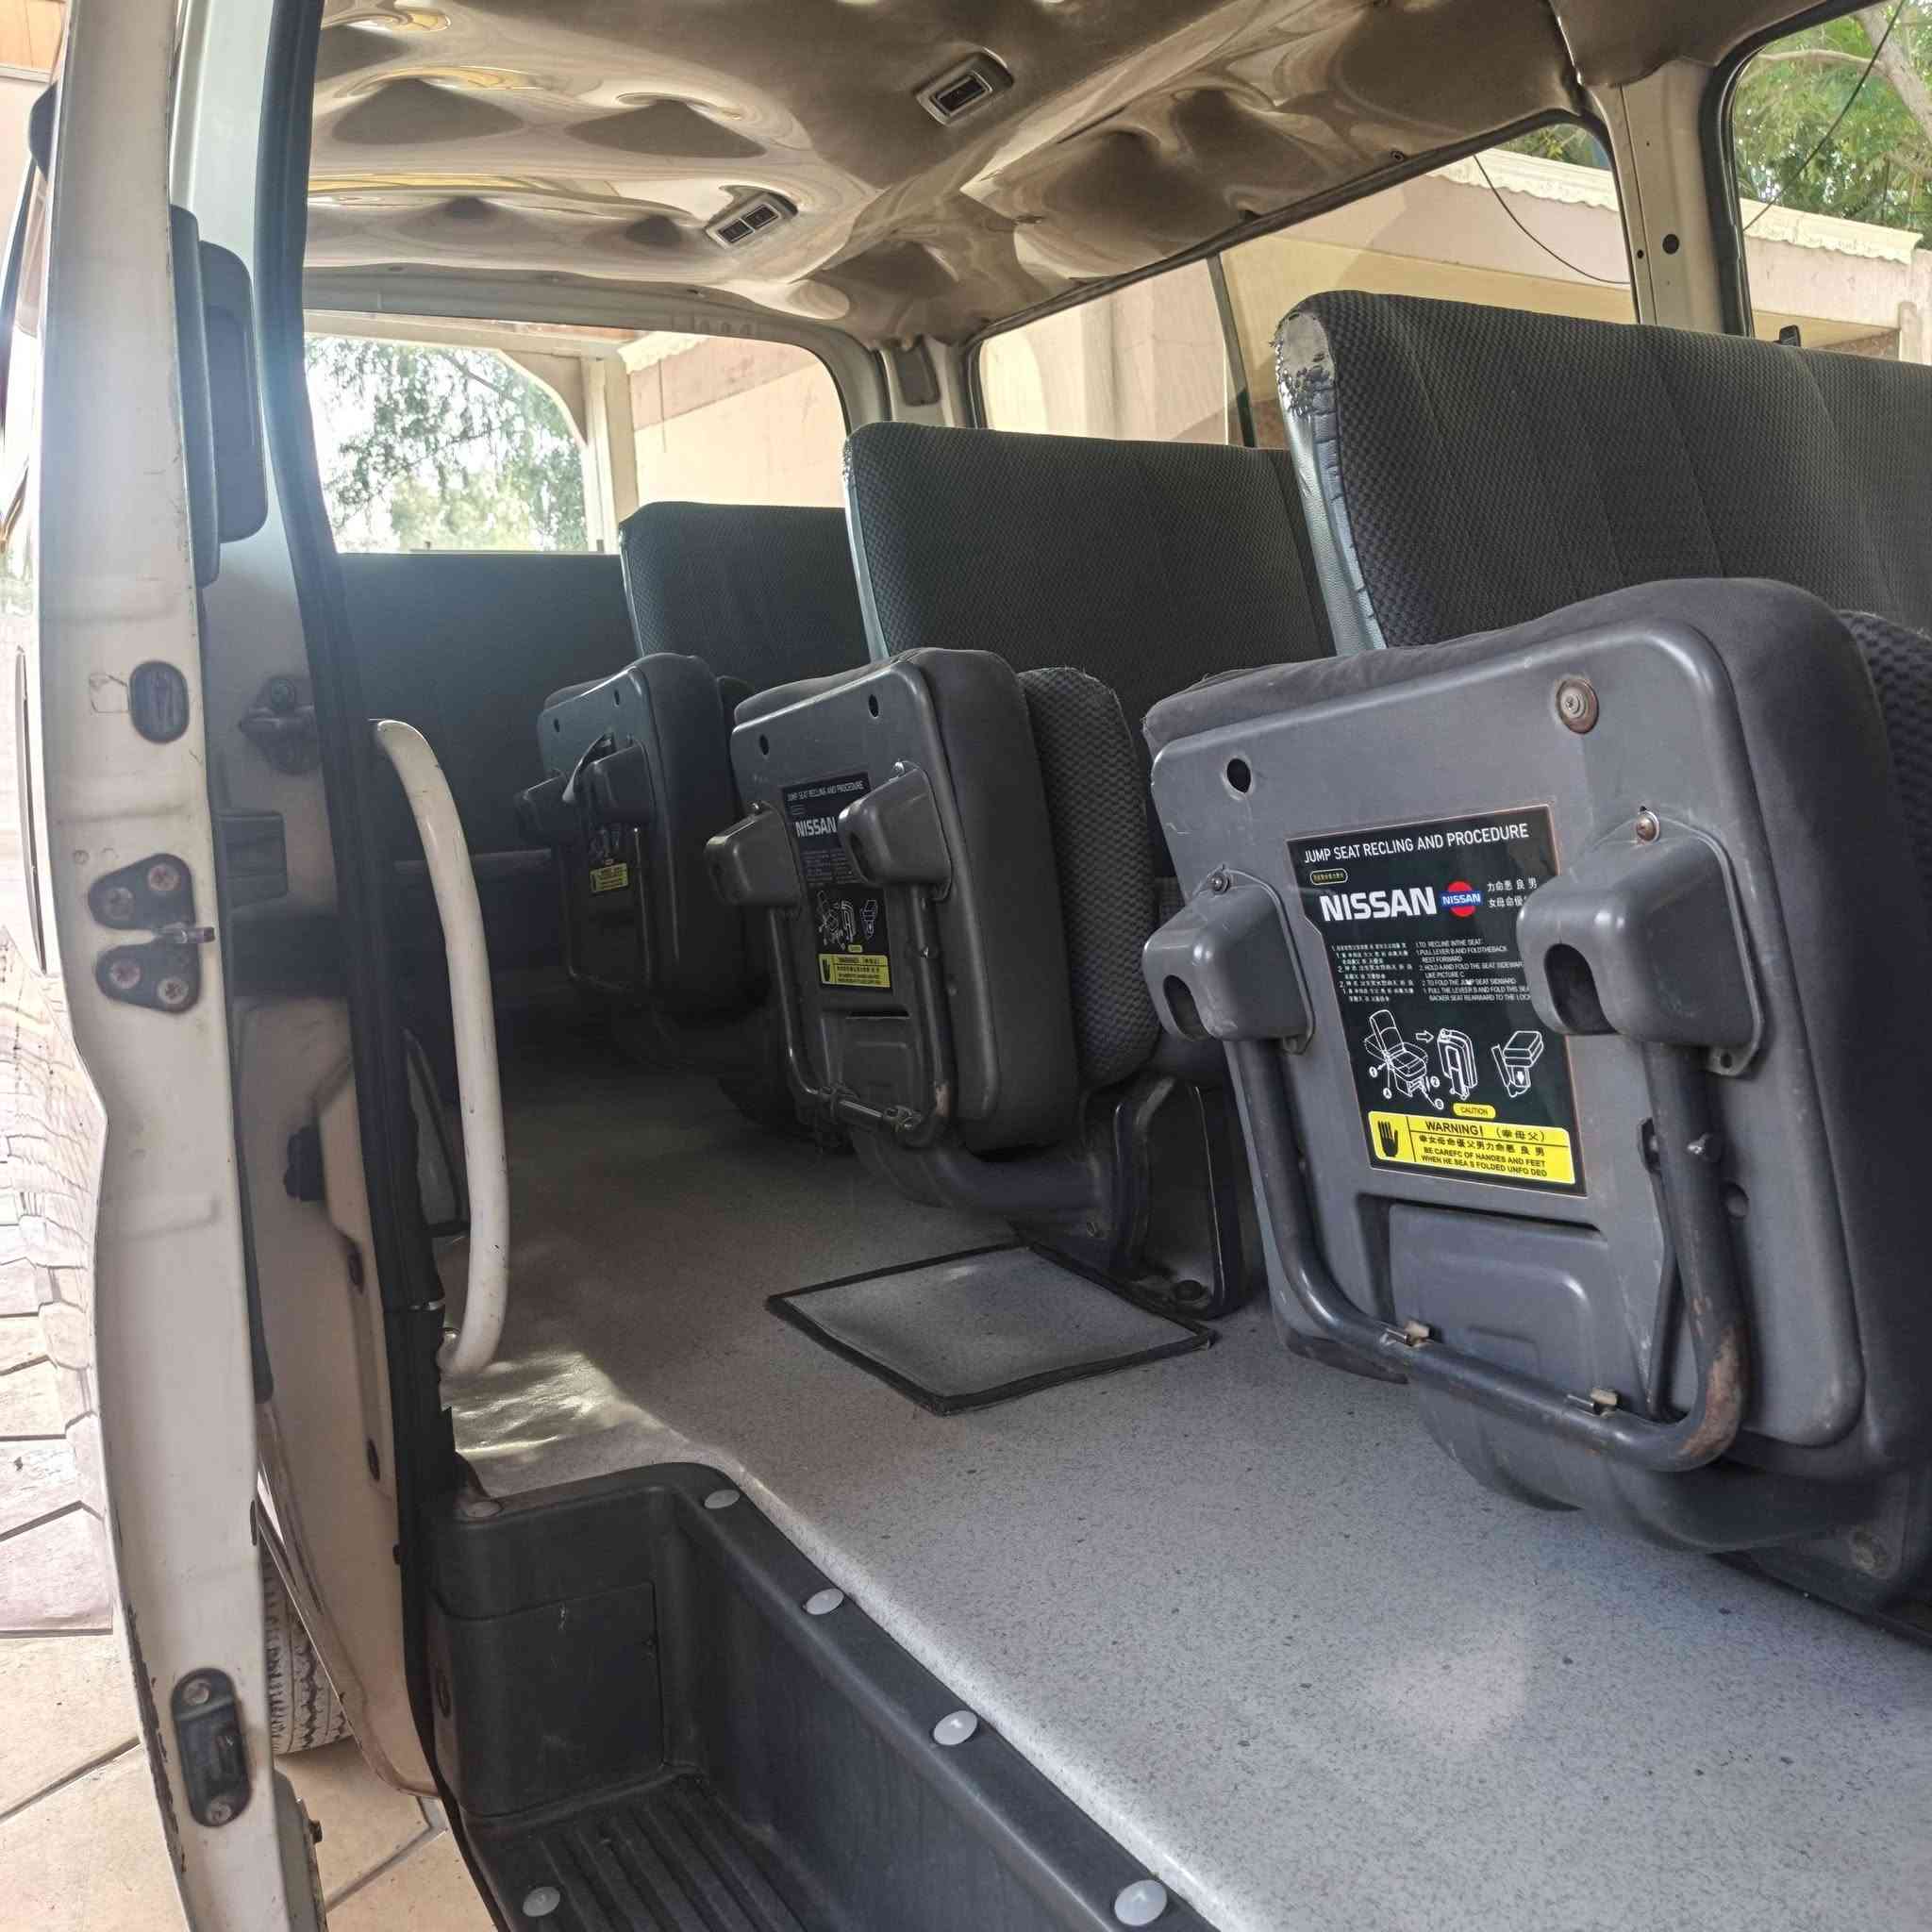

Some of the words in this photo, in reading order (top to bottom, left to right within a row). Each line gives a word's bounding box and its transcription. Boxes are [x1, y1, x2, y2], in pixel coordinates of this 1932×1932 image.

[795, 816, 838, 838] NISSAN
[1305, 847, 1331, 864] JUMP
[1334, 844, 1360, 860] SEAT
[1364, 838, 1414, 857] RECLING
[1417, 834, 1443, 851] AND
[1447, 823, 1530, 847] PROCEDURE
[1320, 886, 1438, 922] NISSAN
[1442, 892, 1482, 906] NISSAN
[1459, 1107, 1488, 1116] CAUTION
[1425, 1120, 1484, 1136] WARNING!
[1424, 1146, 1435, 1155] BE
[1463, 1150, 1473, 1159] OF
[1508, 1157, 1524, 1165] AND
[1525, 1158, 1546, 1167] FEET
[1475, 1160, 1507, 1172] FOLDED
